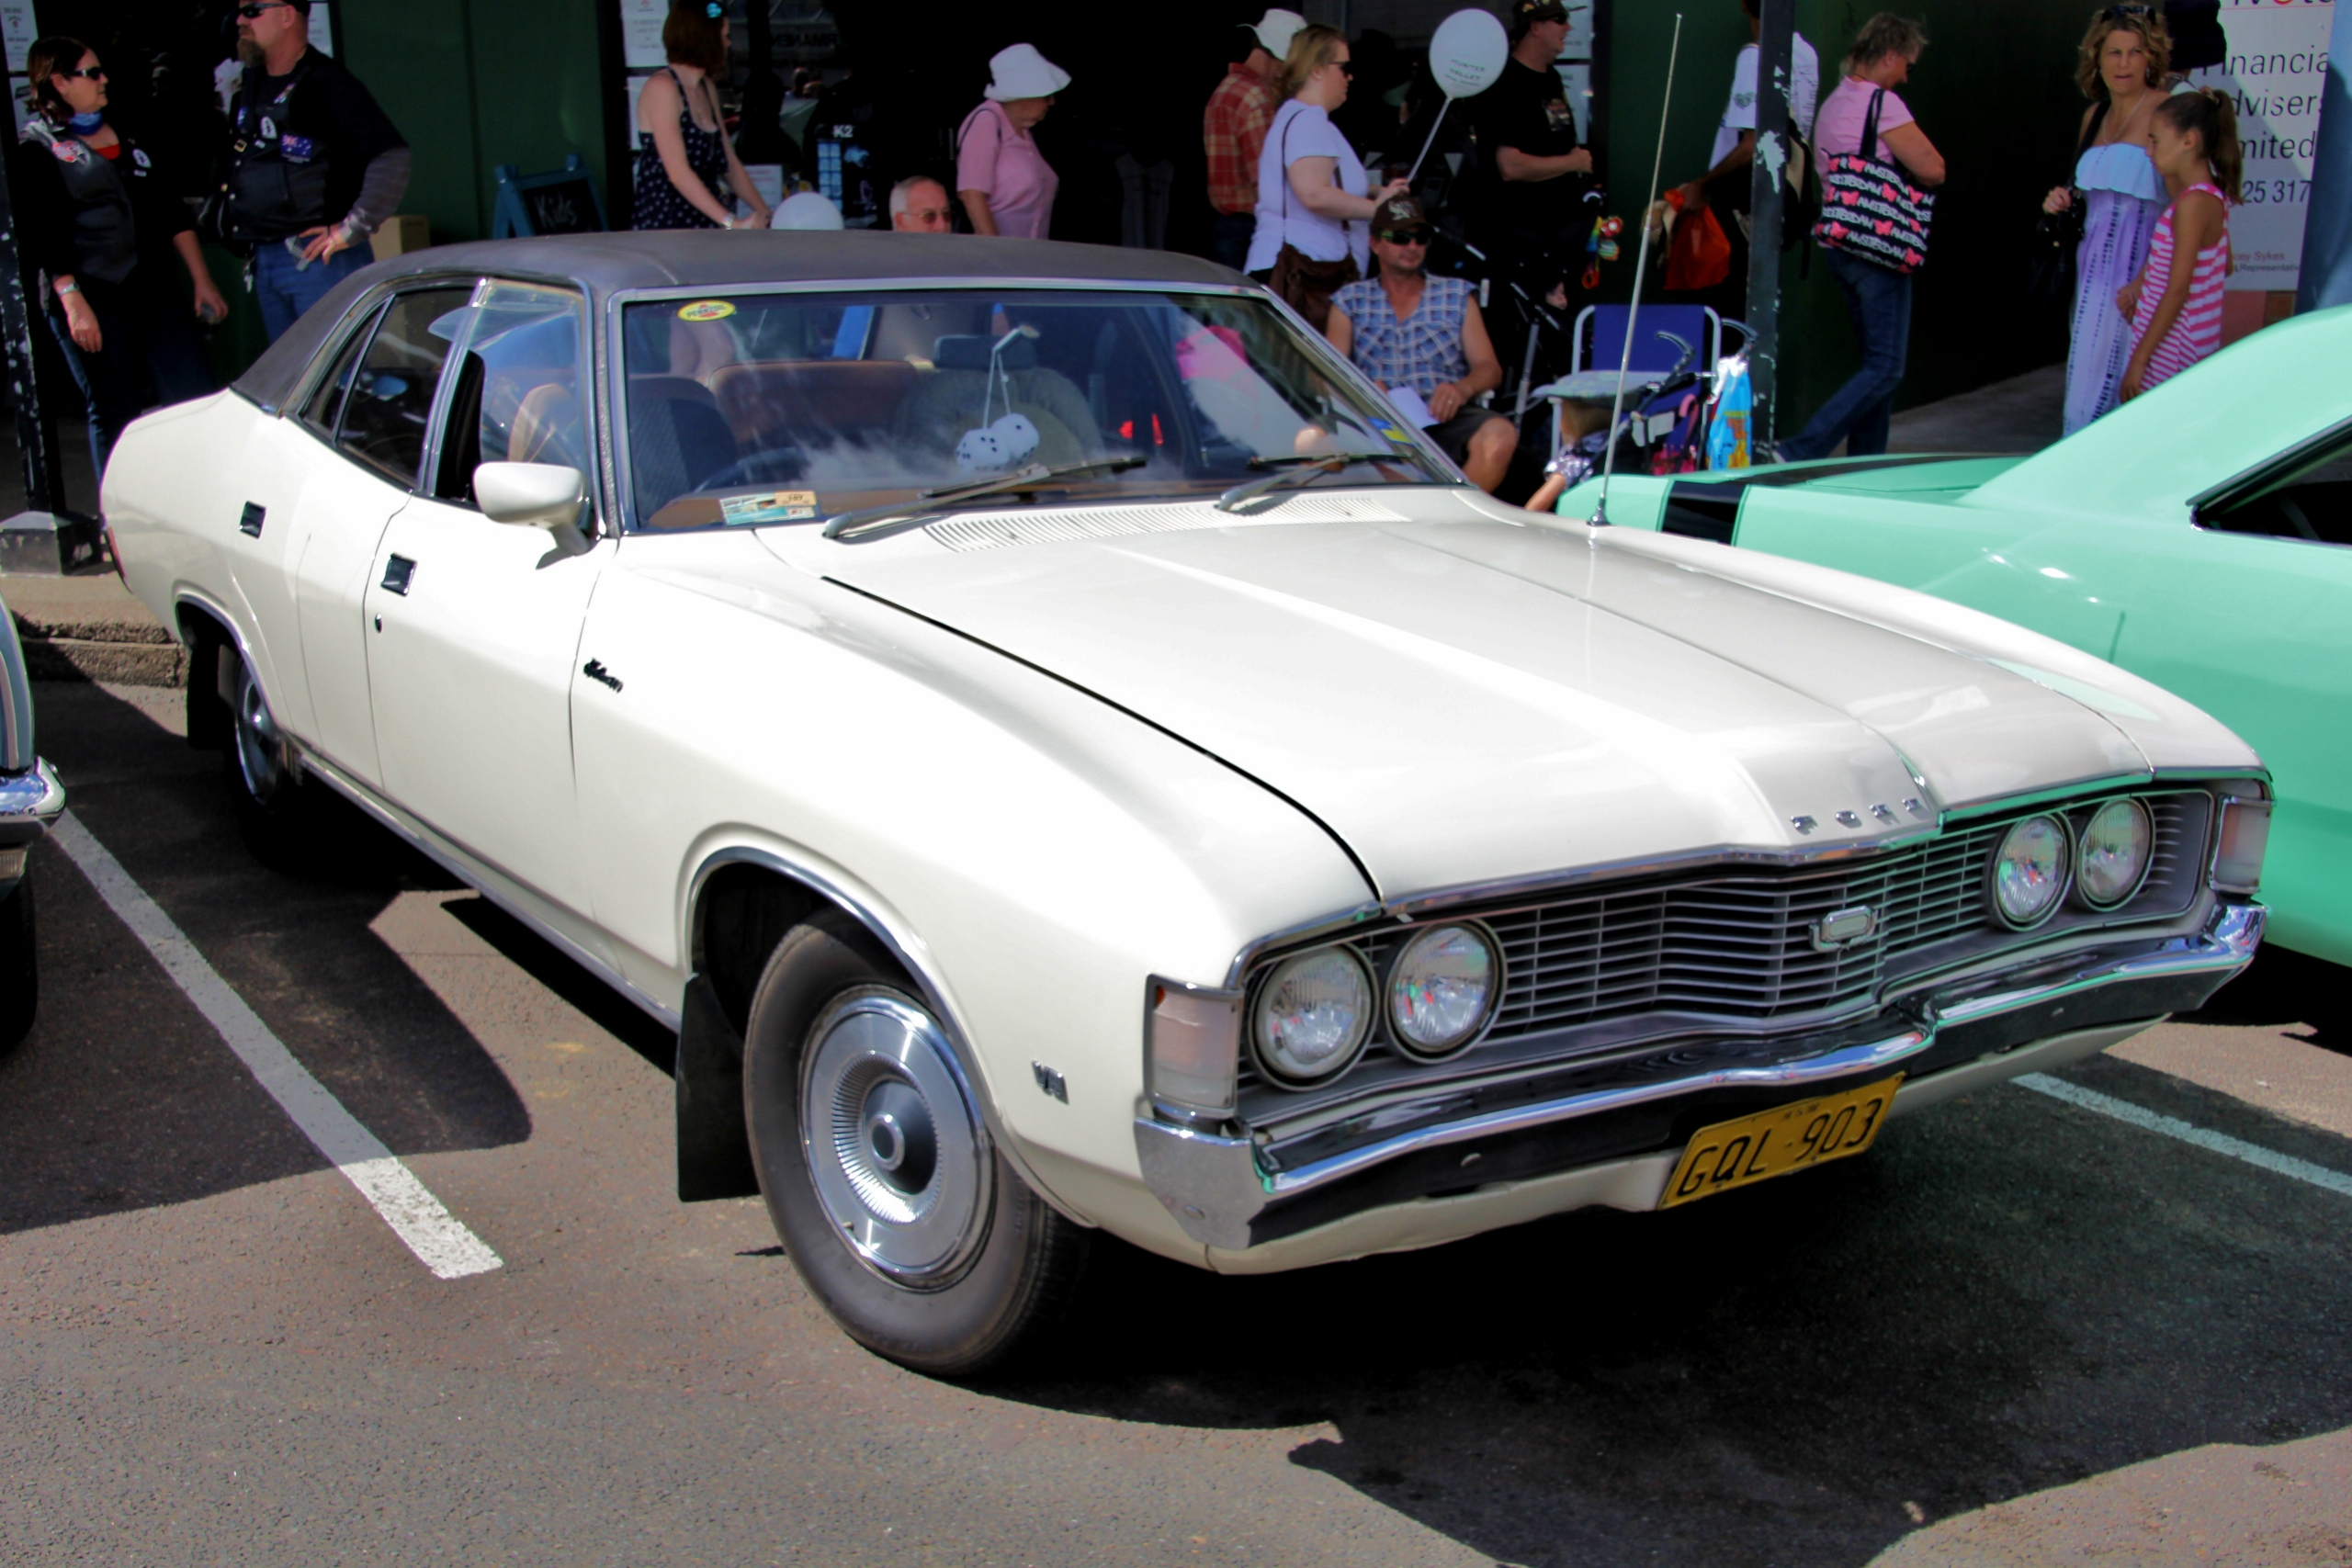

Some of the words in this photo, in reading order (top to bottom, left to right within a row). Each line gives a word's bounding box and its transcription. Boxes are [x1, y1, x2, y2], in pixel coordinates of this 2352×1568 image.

[2230, 89, 2322, 117] dviser
[832, 124, 854, 138] K2
[2238, 130, 2317, 160] mited
[532, 190, 578, 230] Kids
[2254, 251, 2285, 263] Sykes
[1031, 1060, 1069, 1103] V8
[1792, 1098, 1883, 1162] 903
